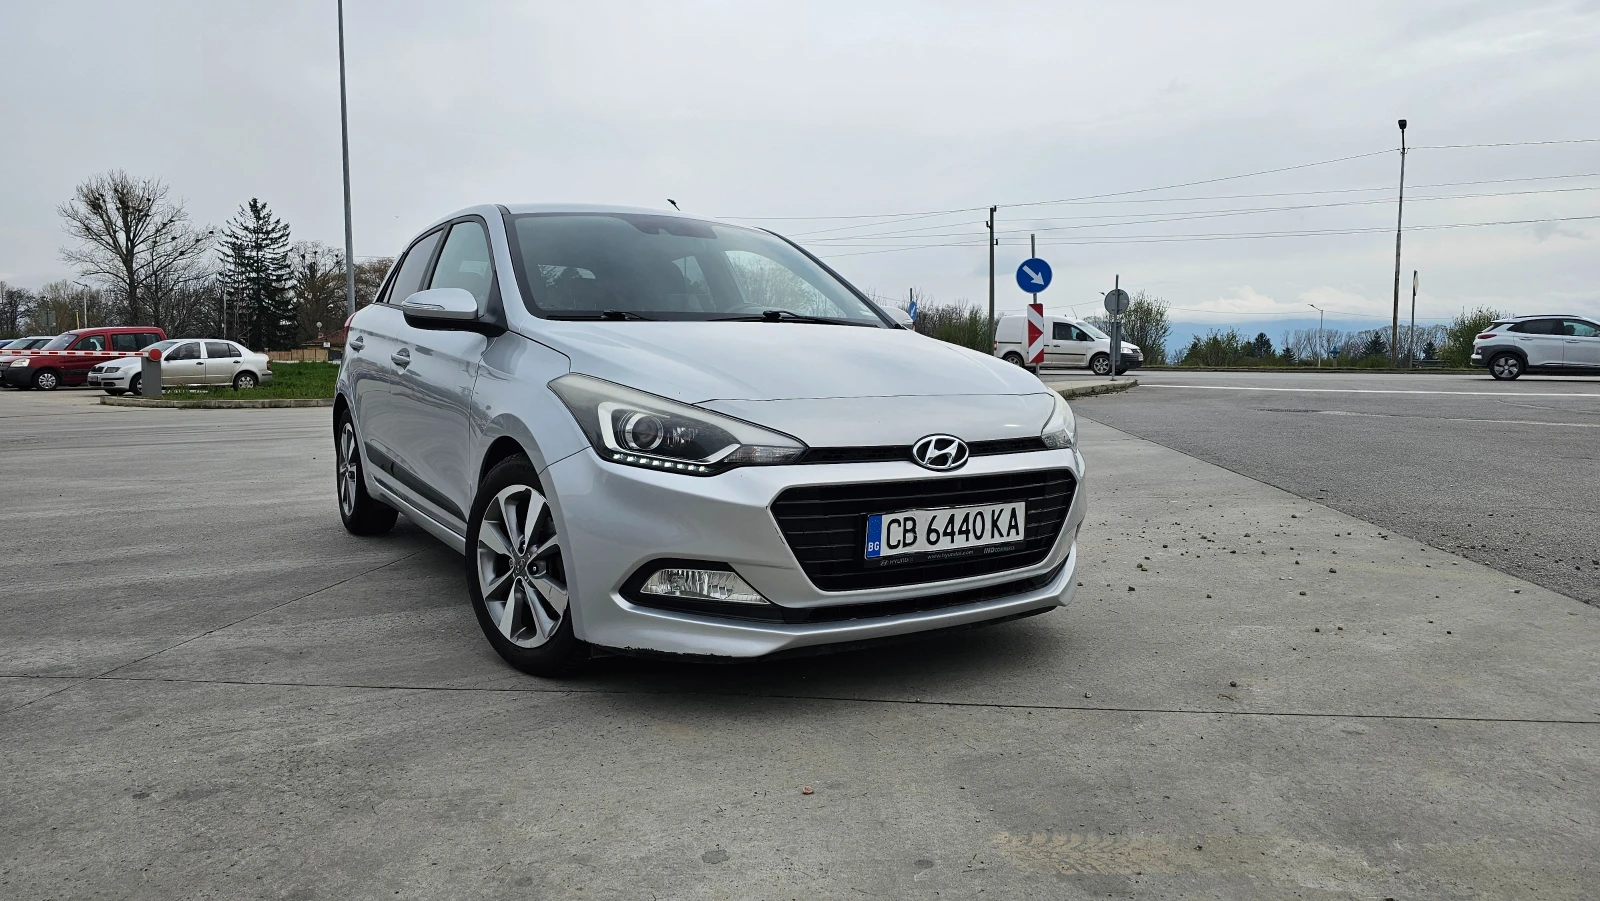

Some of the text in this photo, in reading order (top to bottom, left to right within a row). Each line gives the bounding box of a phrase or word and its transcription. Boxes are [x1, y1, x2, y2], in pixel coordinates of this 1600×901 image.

[886, 507, 1020, 550] CB 6440 KA
[868, 541, 880, 552] BG
